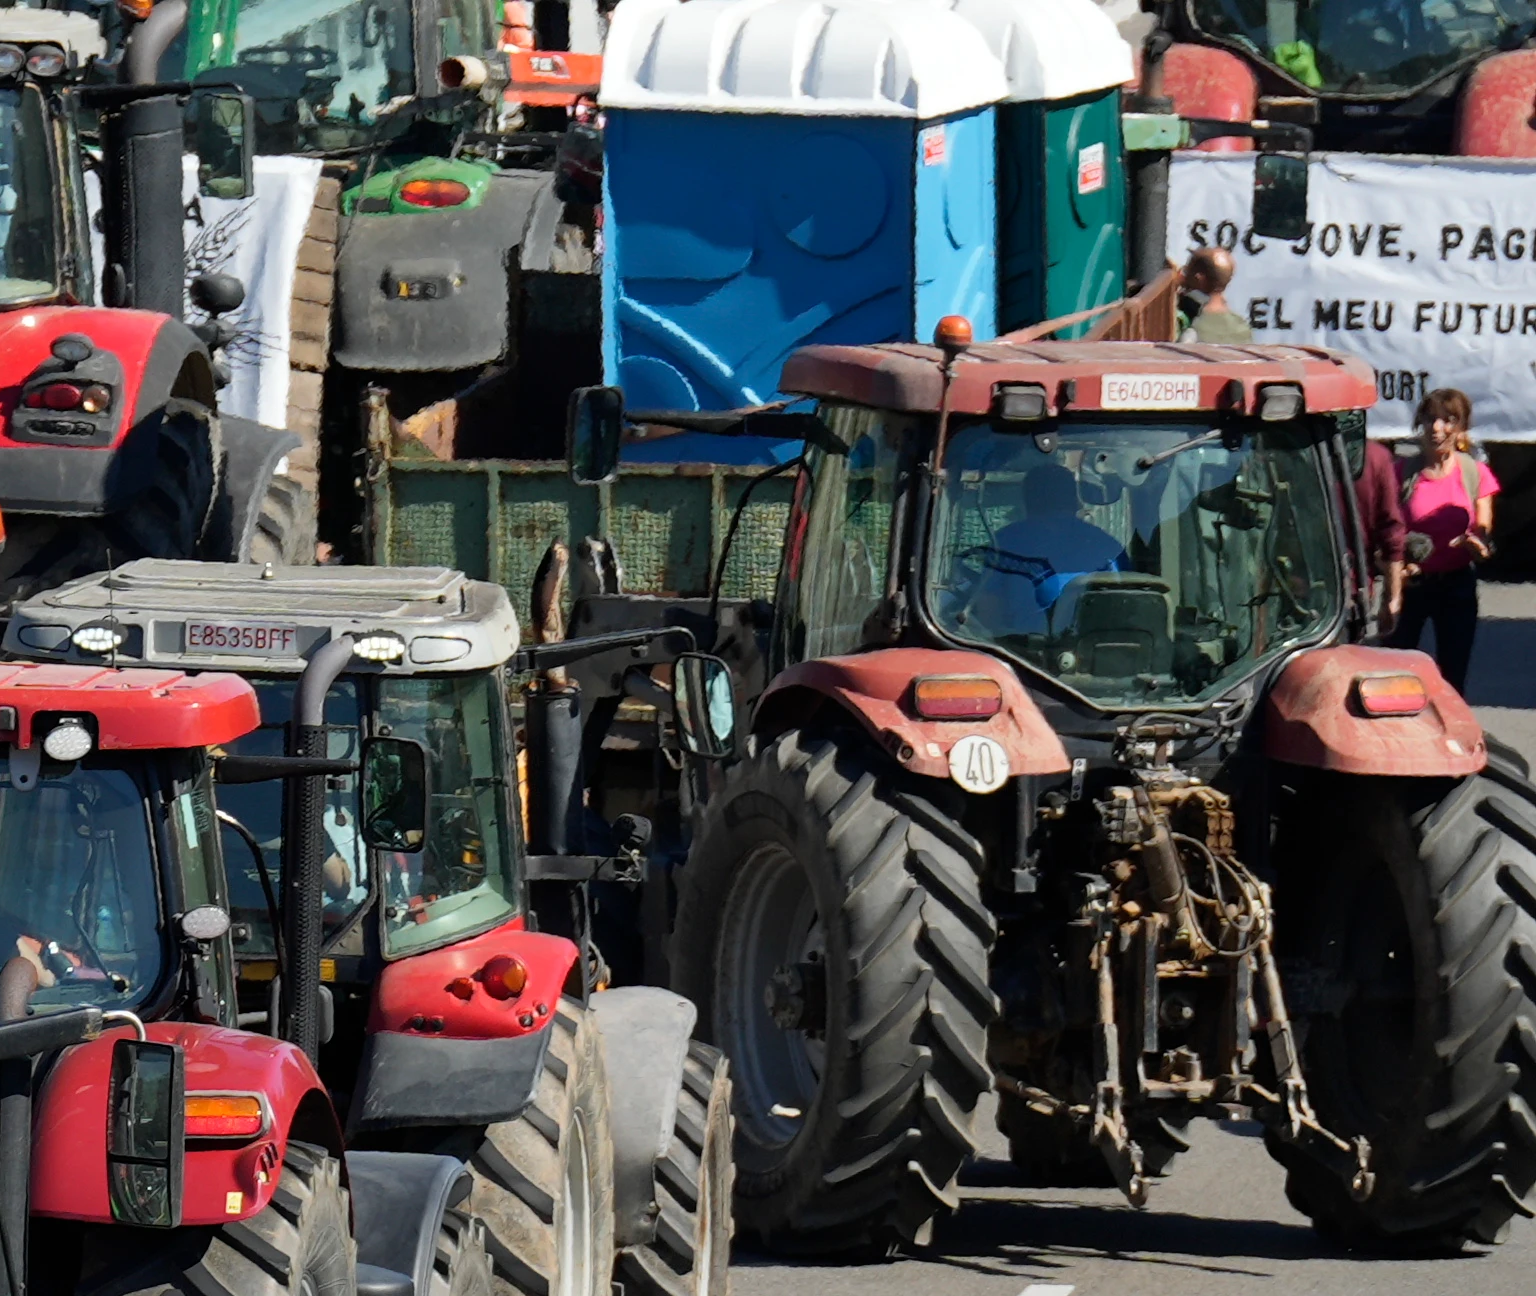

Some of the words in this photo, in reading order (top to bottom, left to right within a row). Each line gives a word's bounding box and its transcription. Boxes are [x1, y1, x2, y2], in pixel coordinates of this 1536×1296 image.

[1249, 297, 1293, 331] EL
[1314, 299, 1393, 333] MEU
[966, 741, 995, 786] 40
